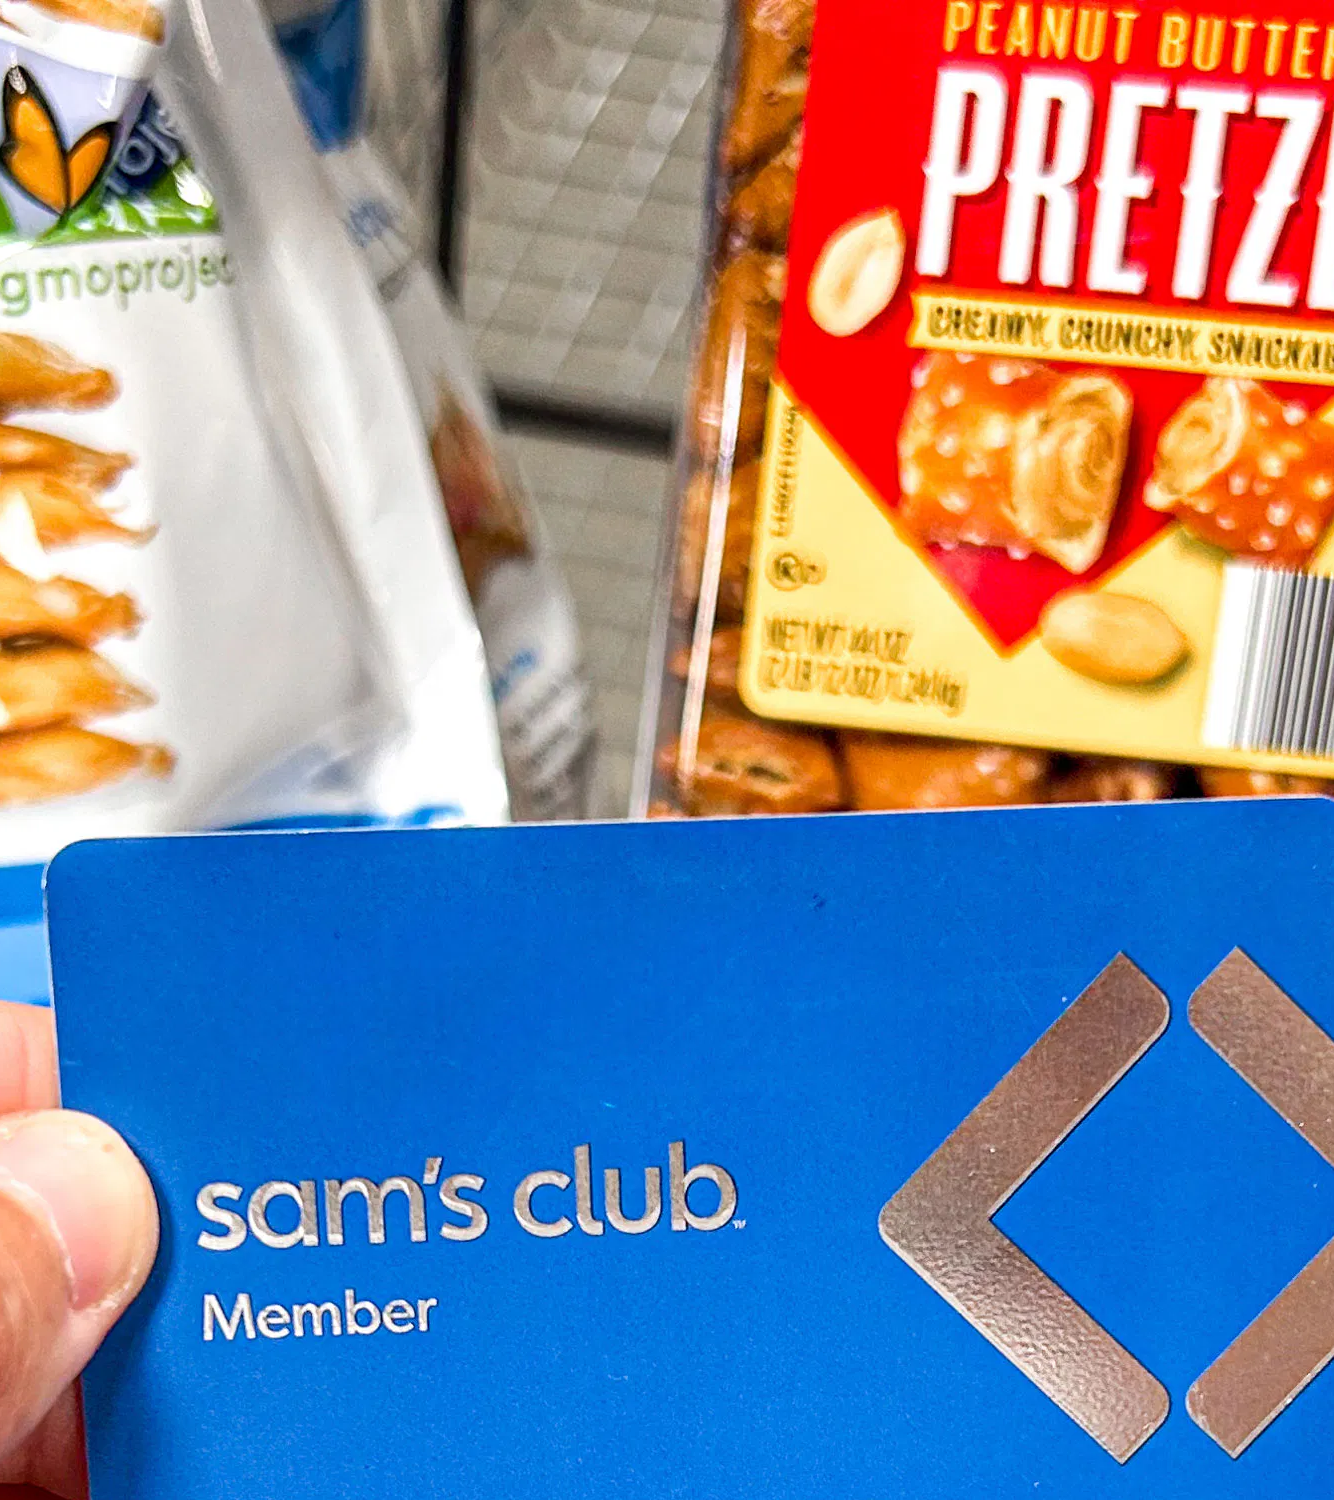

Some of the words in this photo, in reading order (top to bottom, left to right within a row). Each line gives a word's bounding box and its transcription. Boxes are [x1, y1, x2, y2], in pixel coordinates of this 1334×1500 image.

[942, 1, 1140, 64] PEANUT
[196, 1156, 489, 1251] sam's
[202, 1288, 437, 1342] Member
